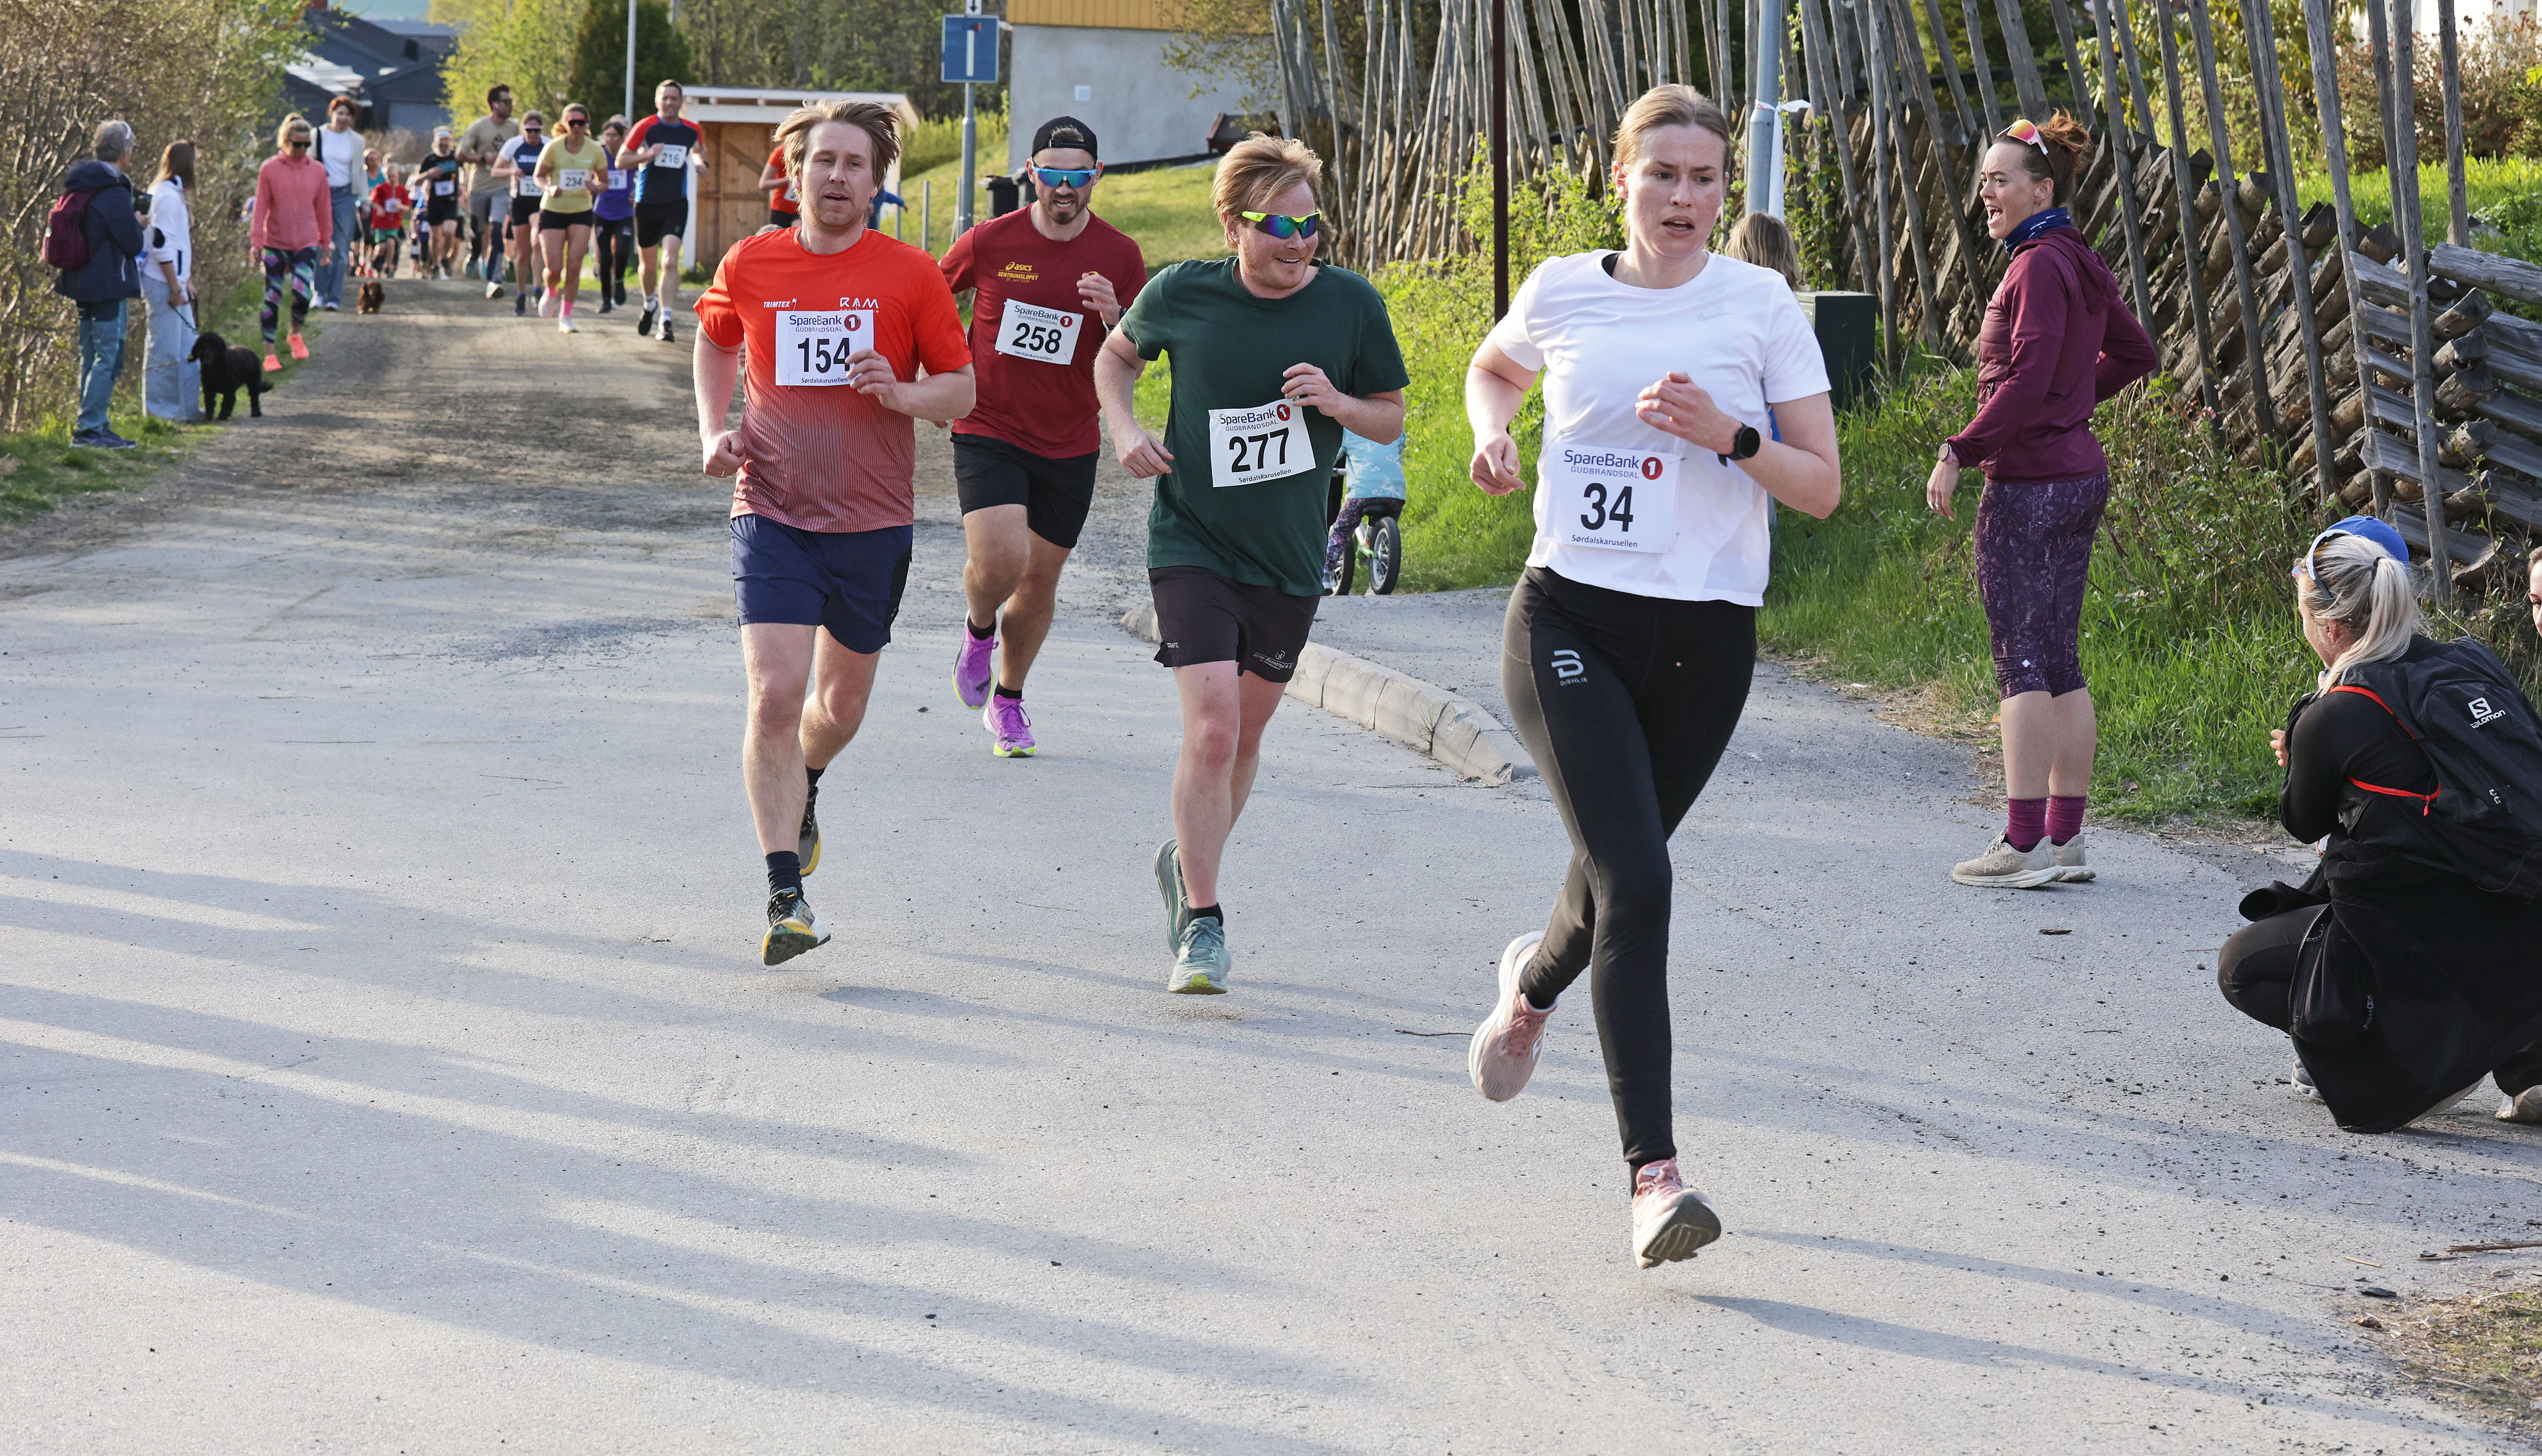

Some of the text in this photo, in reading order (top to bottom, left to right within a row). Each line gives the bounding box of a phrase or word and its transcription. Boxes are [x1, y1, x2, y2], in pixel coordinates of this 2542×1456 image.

[661, 152, 680, 164] 216
[565, 176, 582, 187] 234
[839, 297, 879, 309] RAM
[1014, 305, 1060, 321] SpareBank
[1017, 314, 1058, 326] GUDBRANDSDAL
[789, 315, 842, 327] SpareBank
[1012, 322, 1062, 354] 258
[797, 337, 851, 374] 154
[1014, 350, 1053, 361] Sørdalskarusellen
[1220, 409, 1276, 426] SpareBank
[1225, 419, 1278, 432] GUDBRANDSDAL
[1229, 427, 1289, 473] 277
[1564, 450, 1639, 469] SpareBank
[1239, 469, 1292, 483] Sørdalskarusellen
[1571, 466, 1639, 478] GUDBRANDSDAL
[1580, 482, 1633, 533] 34
[1571, 534, 1638, 548] Sørdalskarusellen
